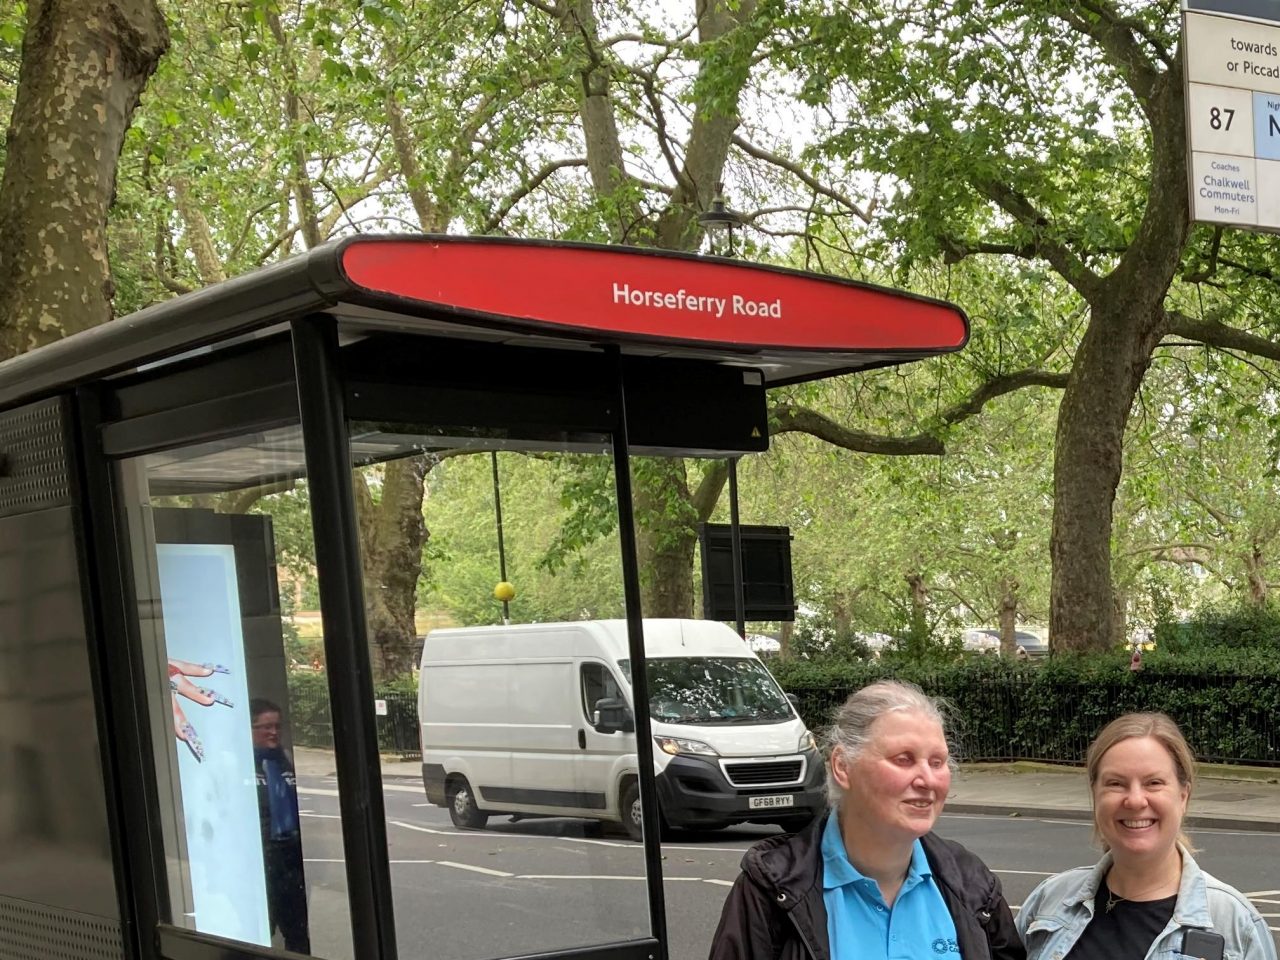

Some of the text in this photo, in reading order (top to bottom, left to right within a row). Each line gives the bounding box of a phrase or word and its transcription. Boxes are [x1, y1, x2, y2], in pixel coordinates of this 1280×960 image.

[1230, 37, 1278, 57] towards
[1226, 61, 1239, 72] or
[1210, 106, 1235, 131] 87
[1211, 161, 1240, 172] Coaches
[1203, 175, 1250, 191] Chalkwell
[1200, 187, 1255, 203] Commuters
[1214, 205, 1240, 215] Mon-Fri
[612, 283, 781, 318] Horseferry Road
